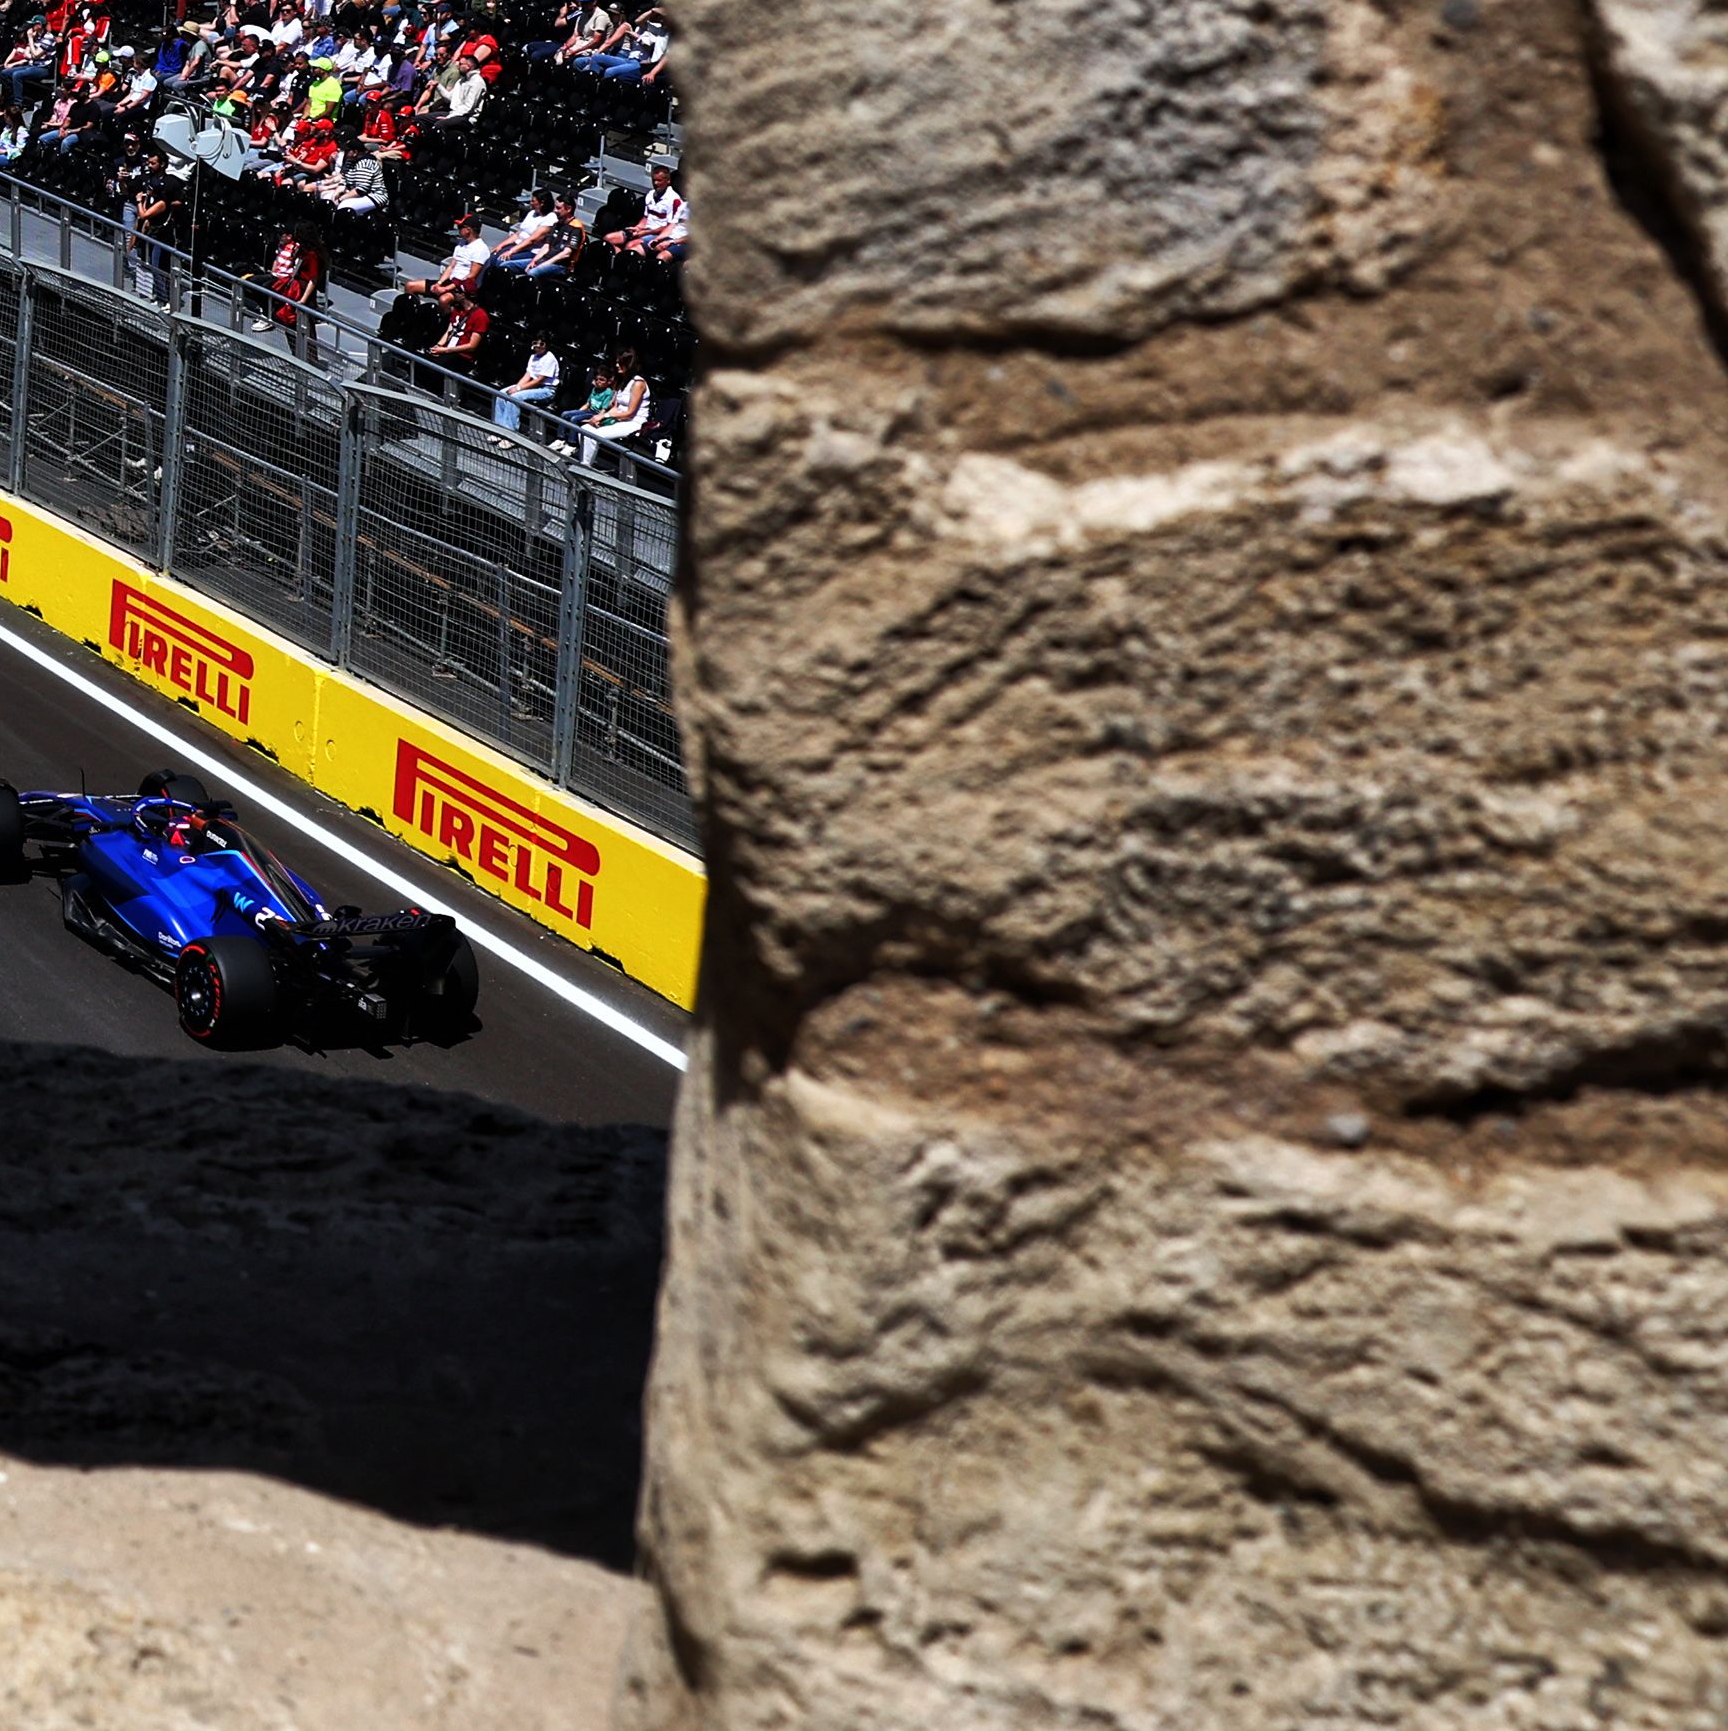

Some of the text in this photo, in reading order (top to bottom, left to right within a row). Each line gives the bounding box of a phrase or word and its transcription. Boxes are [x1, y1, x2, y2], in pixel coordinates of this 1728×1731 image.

[109, 578, 254, 726] PIRELLI
[393, 738, 600, 930] PIRELLI
[339, 913, 432, 933] kraken
